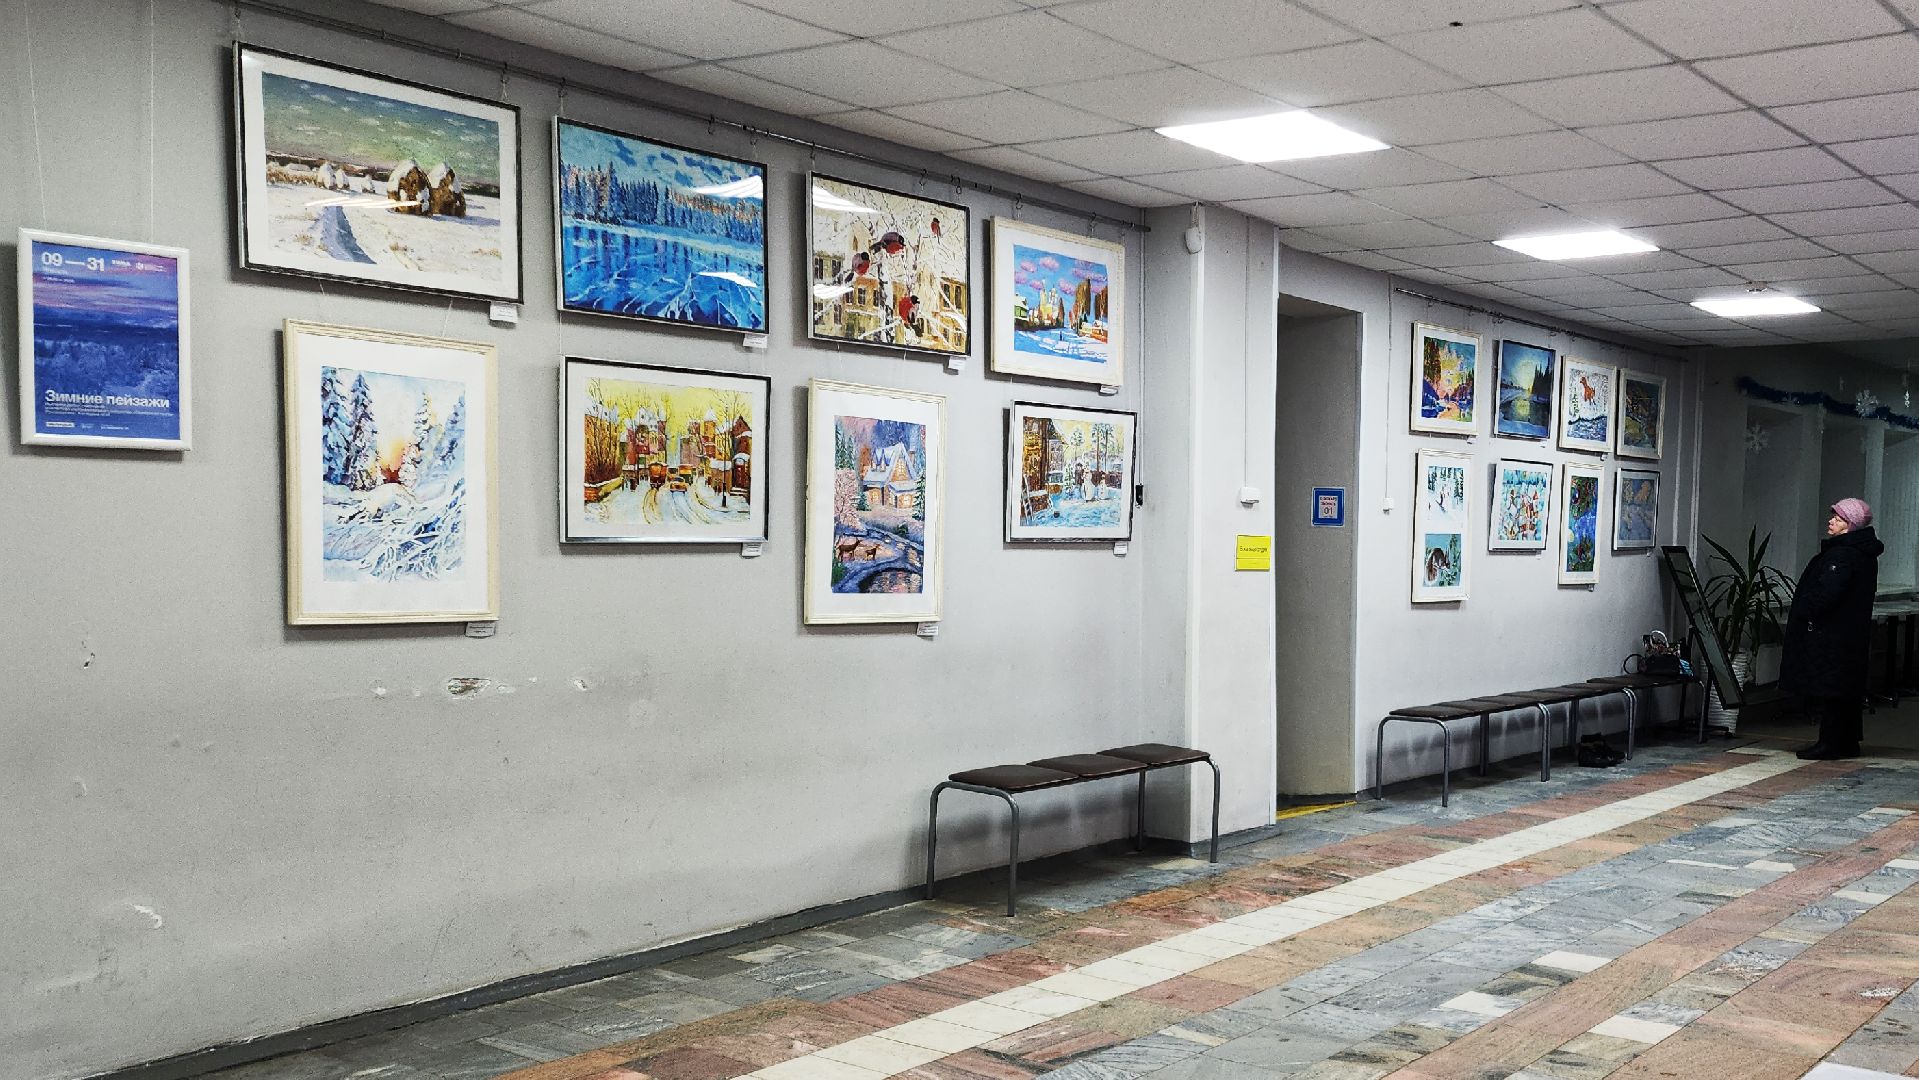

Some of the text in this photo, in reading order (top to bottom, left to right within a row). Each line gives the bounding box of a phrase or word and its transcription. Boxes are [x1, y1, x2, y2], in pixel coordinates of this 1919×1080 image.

[45, 390, 103, 404] Зимние
[106, 394, 170, 408] пейзажи
[1324, 507, 1333, 515] 01
